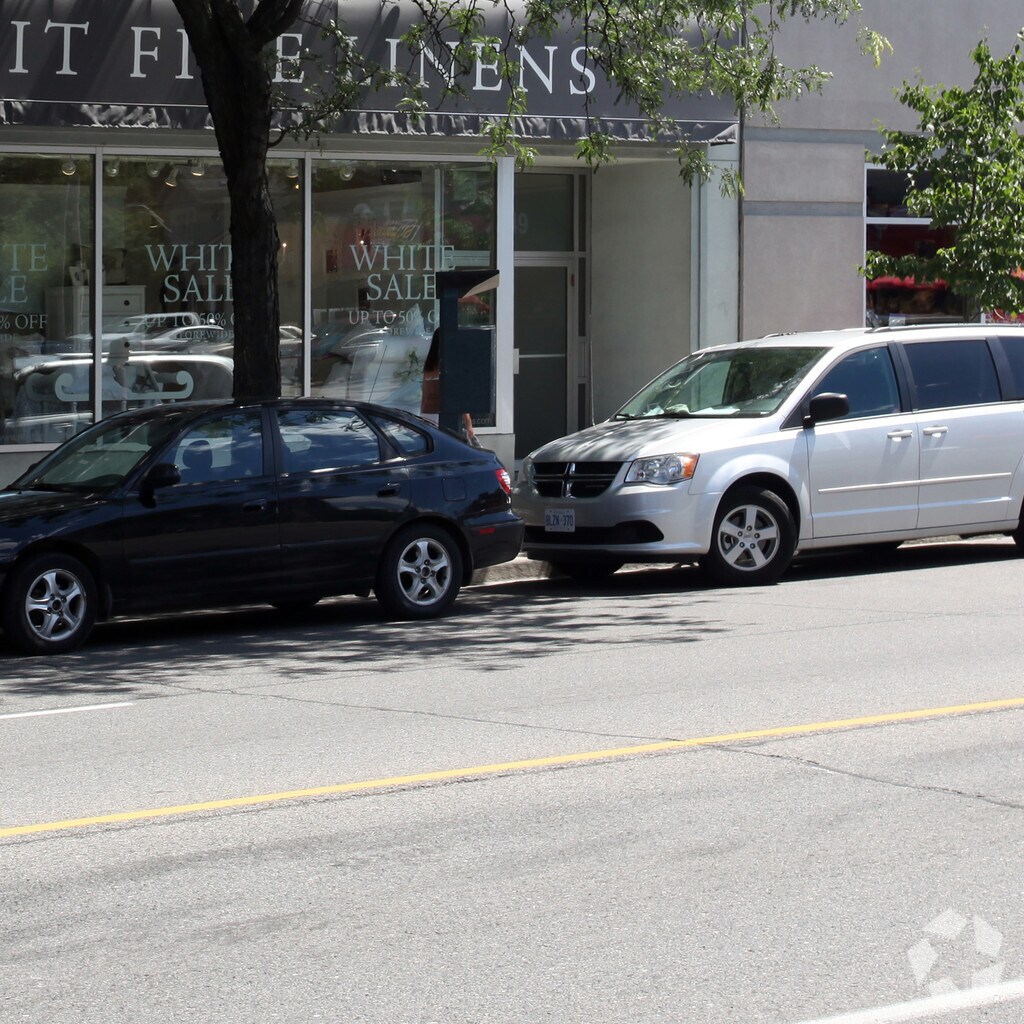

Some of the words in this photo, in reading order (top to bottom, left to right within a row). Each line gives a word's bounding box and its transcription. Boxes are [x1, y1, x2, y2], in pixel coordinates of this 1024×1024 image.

[129, 26, 305, 84] FIE
[145, 244, 232, 272] WHIT
[349, 244, 456, 271] WHITE
[366, 274, 437, 301] SALE
[15, 314, 48, 330] OFF
[349, 310, 369, 325] UP
[372, 309, 395, 325] TO
